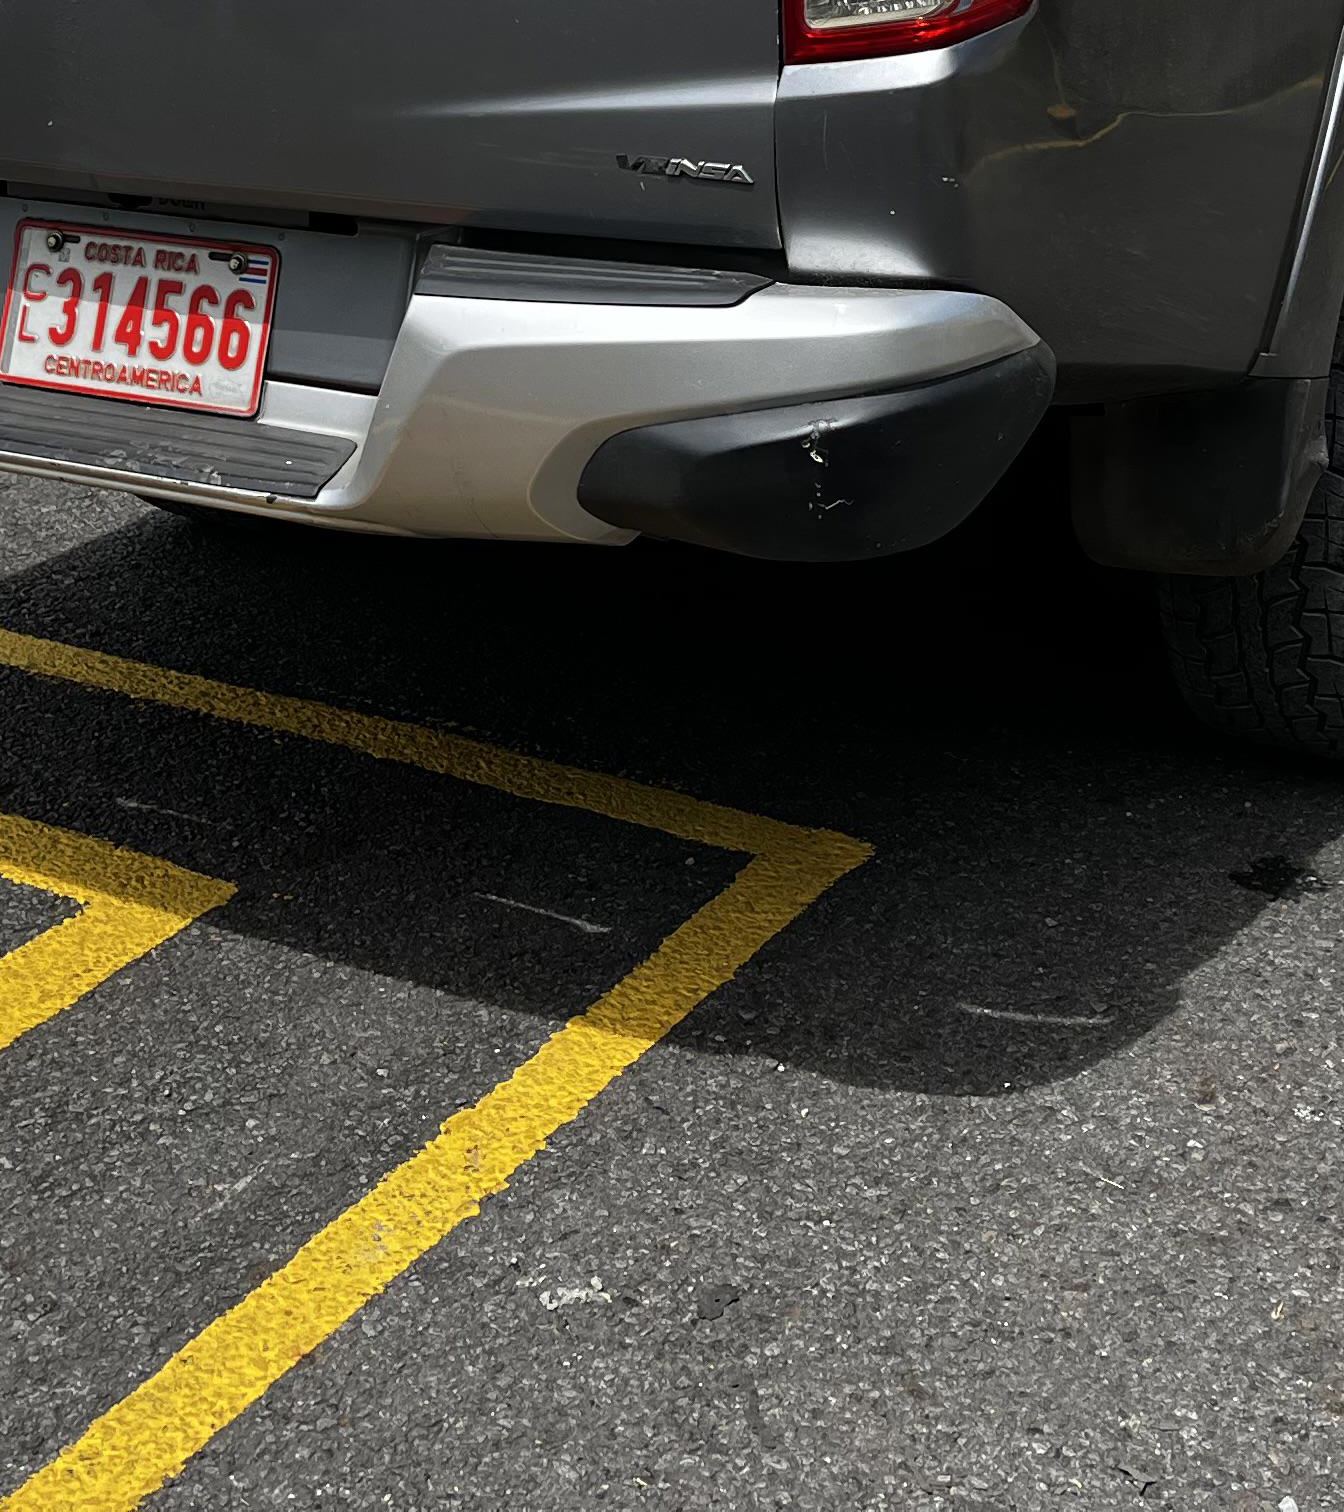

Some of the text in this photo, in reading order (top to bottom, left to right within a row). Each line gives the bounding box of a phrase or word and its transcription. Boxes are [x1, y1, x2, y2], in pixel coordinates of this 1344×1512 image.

[84, 240, 146, 268] COSTA
[153, 249, 200, 275] RICA
[48, 267, 257, 372] 314566
[44, 354, 203, 397] CENTROAMERICA
